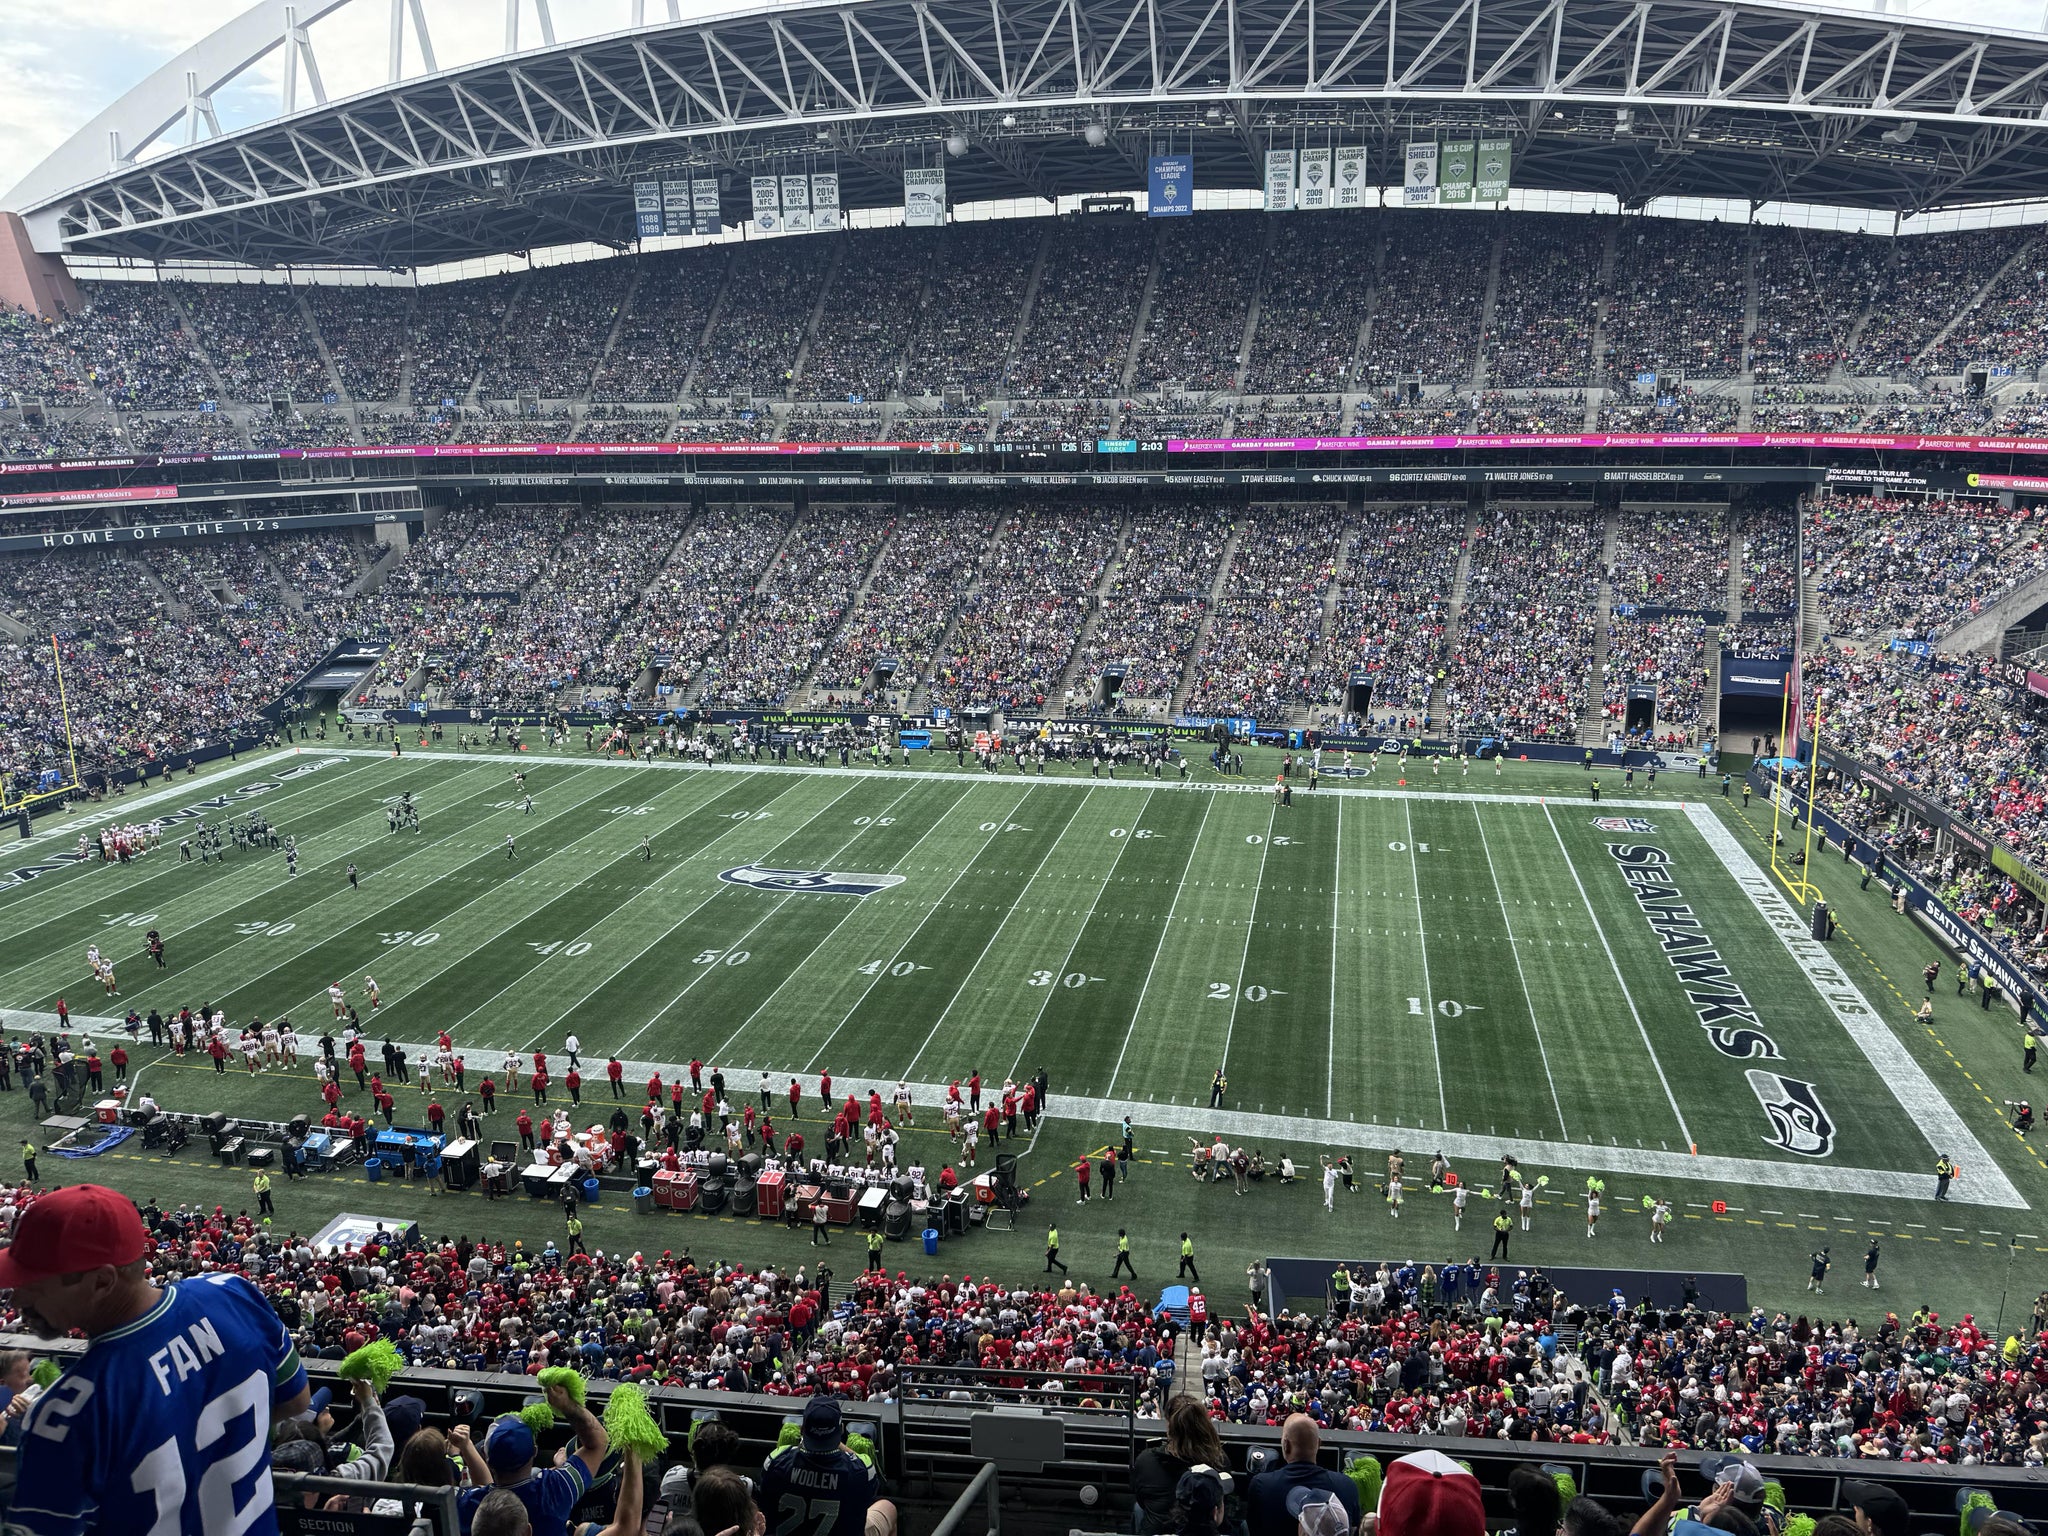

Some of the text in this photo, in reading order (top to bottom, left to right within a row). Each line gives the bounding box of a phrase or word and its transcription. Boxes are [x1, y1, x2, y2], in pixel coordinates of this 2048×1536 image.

[1460, 144, 1474, 152] CUP
[1480, 142, 1510, 151] MLS CUP
[1408, 151, 1435, 159] SHIELD
[1155, 165, 1186, 173] CHAMPIONS
[906, 178, 943, 186] CHAMPIONS
[1442, 182, 1470, 190] CHAMPS
[1478, 180, 1507, 188] CHAMPS
[756, 190, 774, 198] 2005
[786, 189, 804, 197] 2013
[816, 188, 834, 196] 2014
[1447, 190, 1466, 198] 2016
[1482, 189, 1502, 197] 2019
[640, 214, 658, 223] 1988
[641, 224, 659, 233] 1999
[1642, 374, 1651, 383] 12
[1061, 443, 1077, 452] 12:05
[1083, 444, 1092, 452] 25
[60, 458, 134, 468] GAMEDAY MOMENTS
[212, 454, 246, 462] GAMEDAY
[43, 520, 280, 547] HOME OF THE 12s
[1734, 652, 1780, 660] LUMEN
[2005, 663, 2026, 686] 12:05
[868, 715, 946, 731] SETLE
[1003, 719, 1091, 735] SEAHWKS
[1234, 720, 1250, 735] 12
[610, 805, 655, 816] 30
[728, 811, 774, 821] 40
[853, 816, 896, 827] 50
[979, 822, 1023, 834] 40
[1109, 828, 1154, 839] 30
[1246, 834, 1291, 846] 20
[1389, 841, 1430, 853] 10
[381, 931, 441, 947] 30
[537, 941, 593, 957] 40
[1604, 842, 1786, 1061] SEAHAWKS
[1739, 876, 1868, 1016] IT TAKES ALL OF US
[1926, 899, 2023, 996] SEATTLE SEAHAWKS
[692, 949, 751, 967] 50
[857, 959, 915, 978] 40
[1027, 970, 1088, 989] 30
[1207, 982, 1269, 1002] 20
[1406, 997, 1464, 1018] 10
[1192, 1301, 1206, 1314] 42
[1514, 1300, 1524, 1312] 31
[149, 1317, 226, 1396] FAN
[130, 1369, 274, 1536] 12
[790, 1467, 839, 1491] WOOLEN
[775, 1493, 841, 1536] 27
[299, 1518, 355, 1533] SECTION
